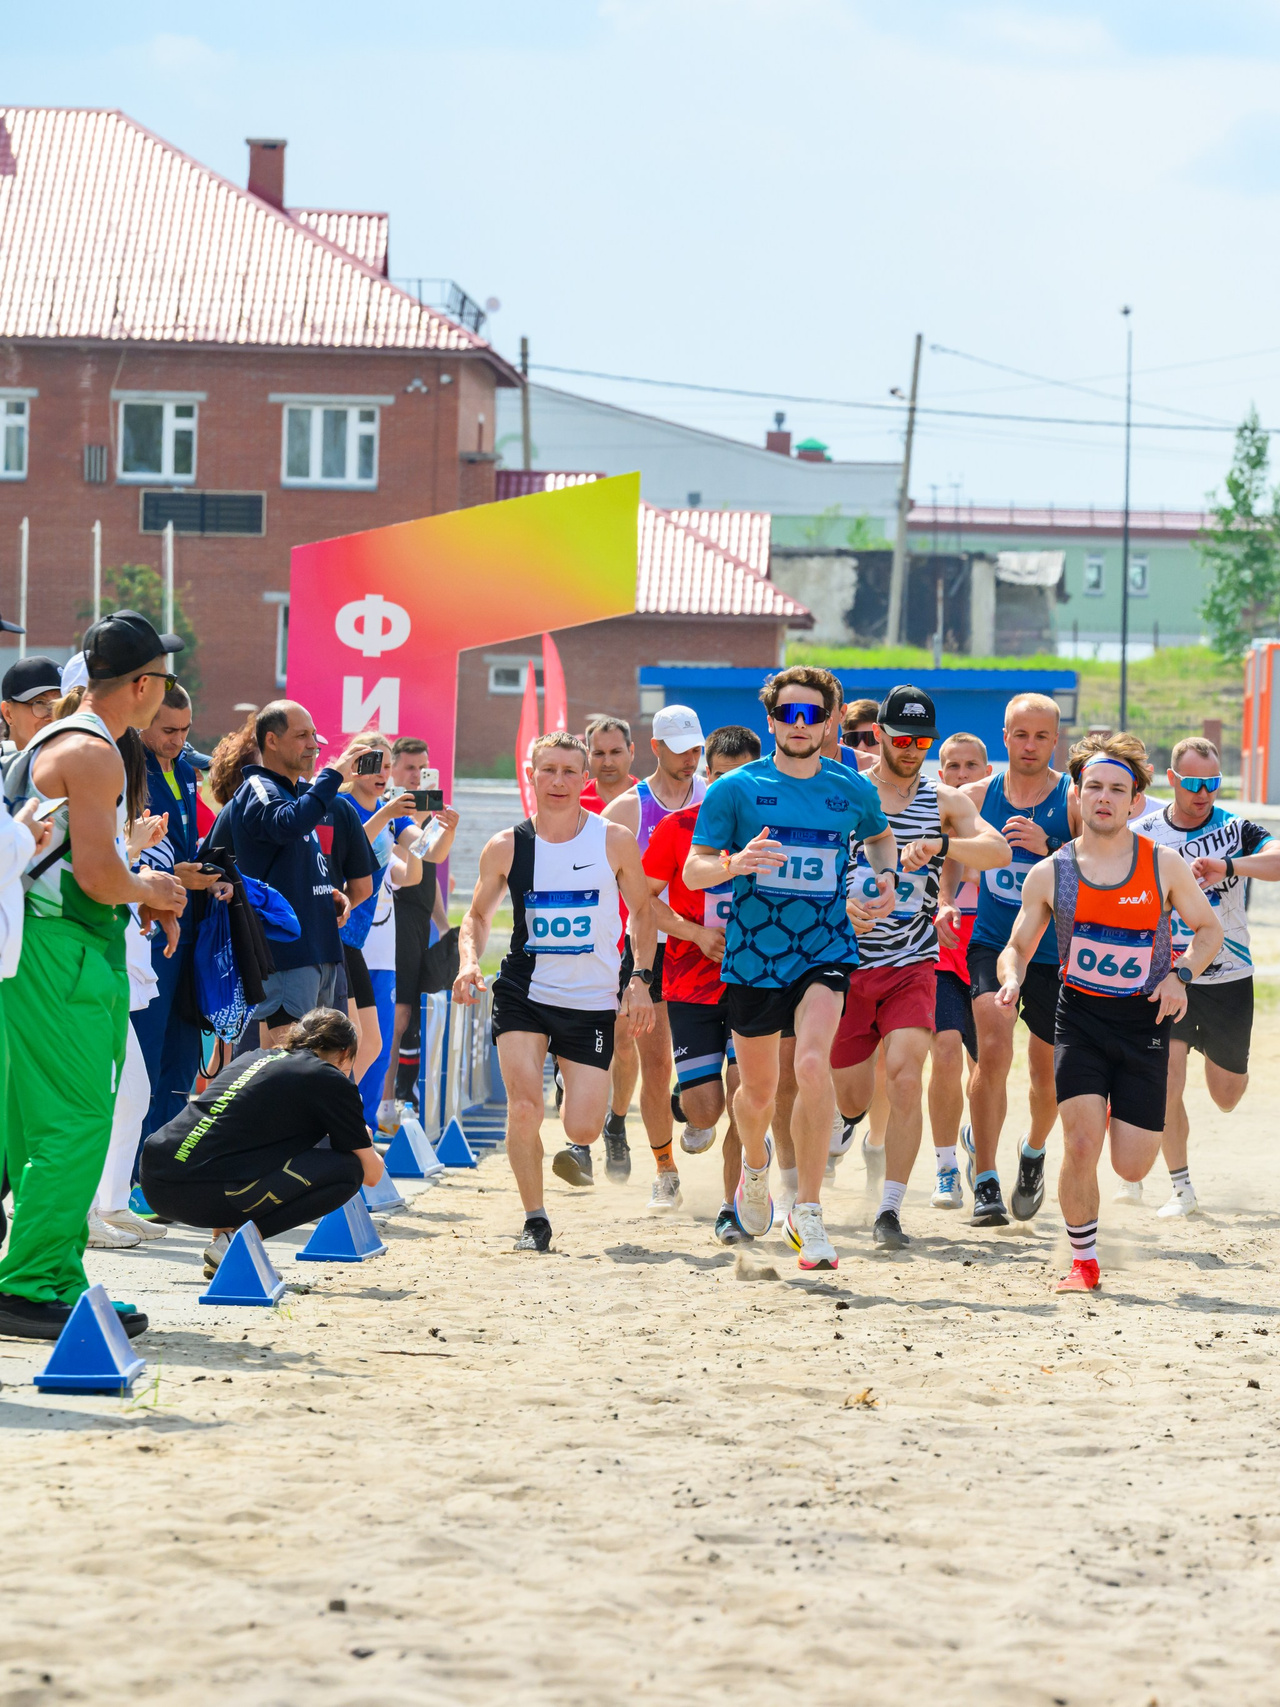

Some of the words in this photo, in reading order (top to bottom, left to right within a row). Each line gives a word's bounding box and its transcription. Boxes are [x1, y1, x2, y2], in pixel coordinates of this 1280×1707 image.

[863, 877, 915, 902] 09
[996, 869, 1027, 893] 05
[532, 915, 591, 938] 003
[1077, 948, 1142, 978] 066
[209, 1089, 238, 1115] БЫТЬ
